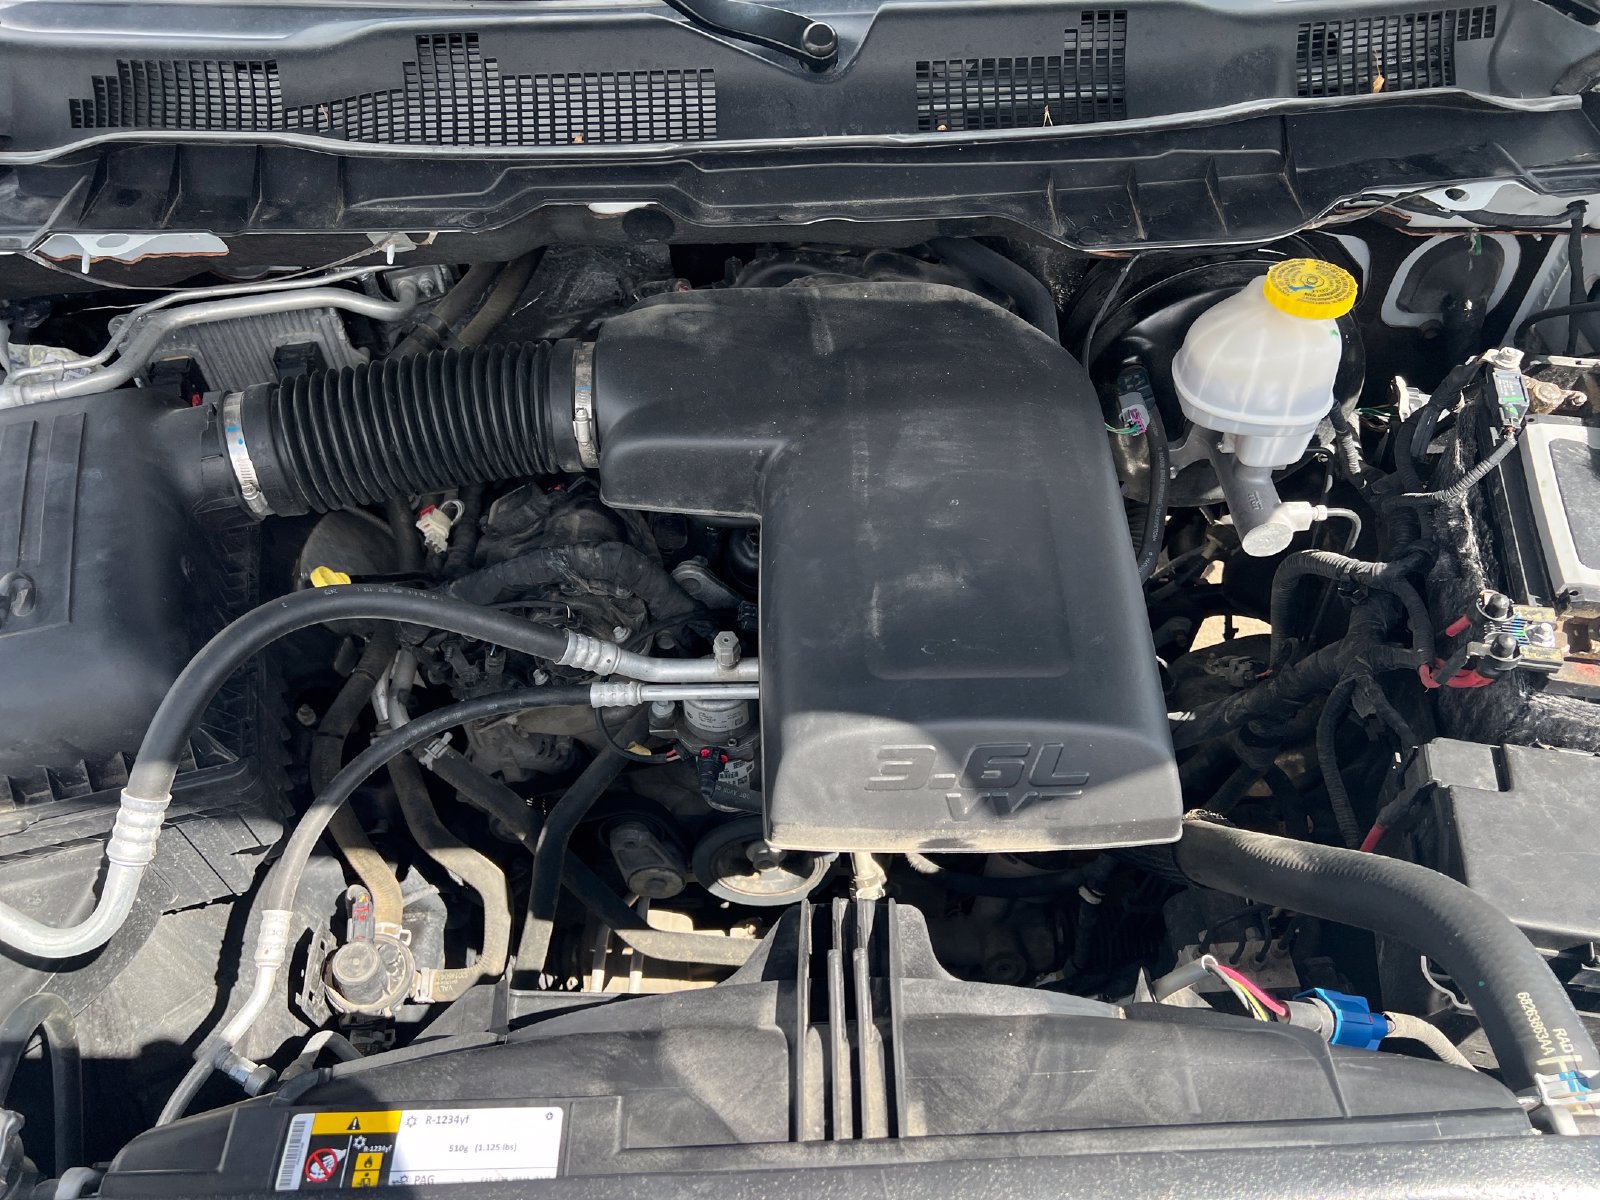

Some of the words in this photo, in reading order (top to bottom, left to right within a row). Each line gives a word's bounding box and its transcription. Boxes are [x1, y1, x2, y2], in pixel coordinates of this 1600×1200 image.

[864, 742, 1090, 791] 3.6L
[1516, 992, 1556, 1056] 68263863AA
[1553, 1028, 1574, 1054] RAD
[425, 1114, 470, 1126] R-1234yf
[449, 1144, 469, 1153] 510g
[475, 1143, 500, 1153] (1.125
[502, 1143, 517, 1153] lbs)
[414, 1175, 435, 1185] PAG
